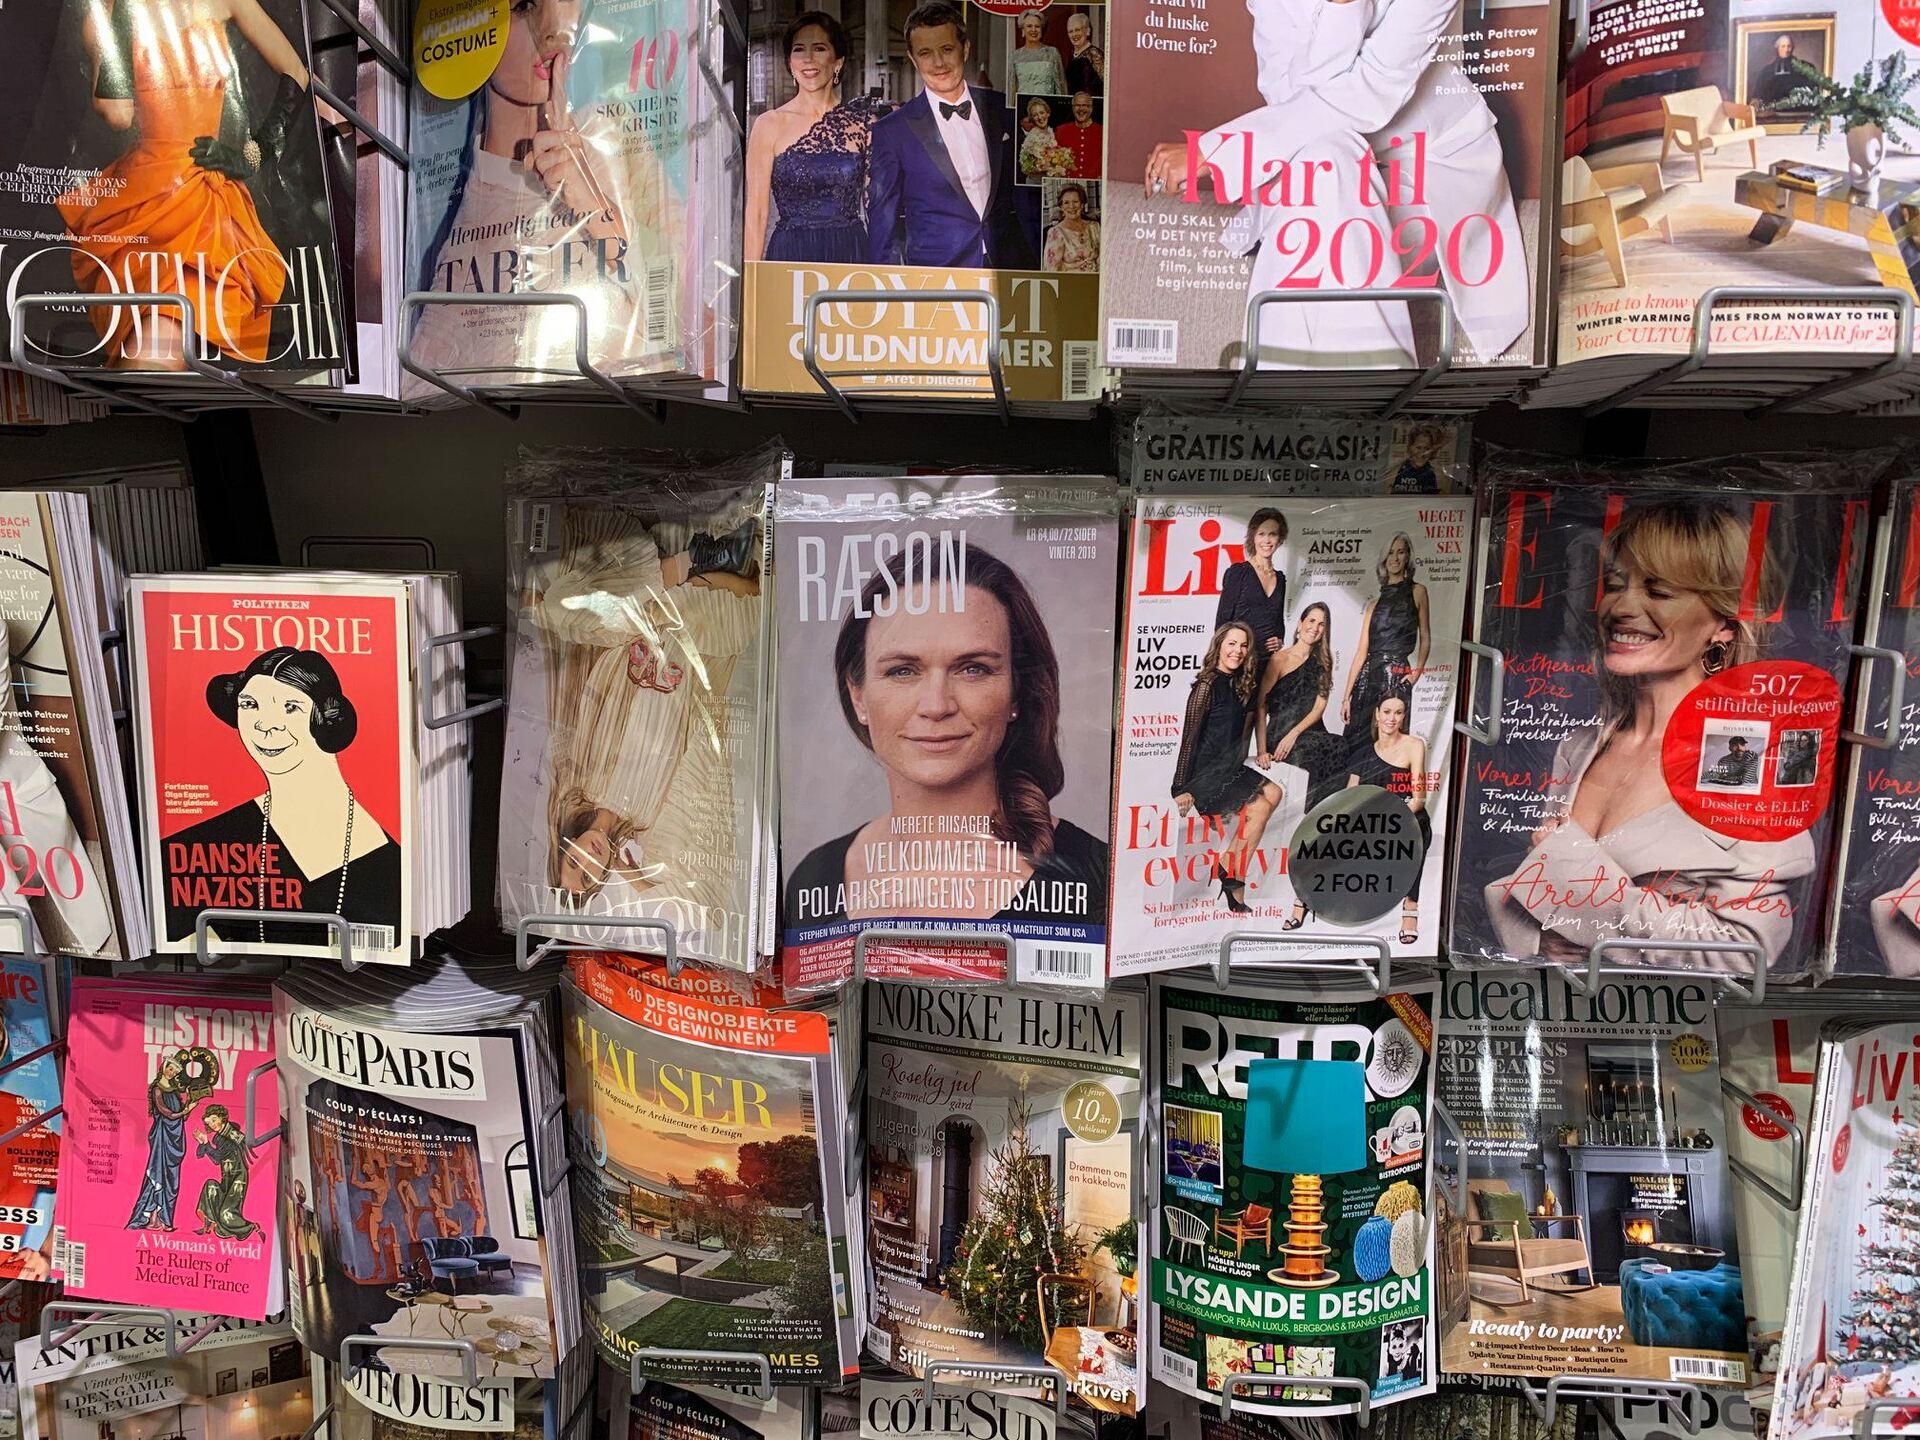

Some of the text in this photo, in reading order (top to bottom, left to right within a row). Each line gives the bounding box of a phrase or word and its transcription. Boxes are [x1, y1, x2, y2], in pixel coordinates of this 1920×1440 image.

[1145, 12, 1210, 32] du huske
[1591, 0, 1699, 34] FROM LONDON'S
[421, 28, 497, 64] COSTUME
[1136, 32, 1217, 55] 10'erne for?
[1600, 30, 1685, 58] LAST-MINUTE
[1606, 41, 1678, 65] GIFT IDEAS
[626, 30, 680, 94] 10
[1427, 45, 1535, 63] Caroline Søeborg
[1451, 62, 1510, 76] Ahlefeldt
[17, 163, 102, 178] Regreso al pasado
[1180, 129, 1428, 207] Klar til
[22, 193, 97, 206] DE LO RETRO
[1131, 212, 1250, 228] ALT DU SKAL VIDE
[1135, 228, 1217, 242] OM DET NYE
[1275, 213, 1505, 289] 2020
[1159, 260, 1249, 275] film, kunst &
[1156, 275, 1248, 290] begivenheder
[785, 269, 1059, 333] ROYALT
[1577, 313, 1690, 331] WINTER-WARMING
[1788, 312, 1841, 320] NORWAY
[1848, 312, 1862, 320] TO
[1867, 312, 1888, 320] THE
[1576, 324, 1873, 350] Your CALENDAR for
[1146, 434, 1380, 461] GRATIS MAGASIN
[1144, 469, 1377, 482] EN GAVE TIL DEJLIGE DIG FRA OS!
[1144, 505, 1223, 518] MAGASINET
[1418, 510, 1465, 524] MEGET
[1026, 528, 1036, 541] KR
[1074, 528, 1097, 541] SIDER
[1425, 526, 1464, 539] MERE
[1049, 546, 1096, 560] VINTER 2019
[1309, 540, 1362, 554] ANGST
[1436, 540, 1462, 554] SEX
[798, 530, 966, 622] RÆSON
[232, 599, 310, 610] POLITIKEN
[170, 613, 372, 654] HISTORIE
[1137, 625, 1205, 634] SE VINDERNE!
[1137, 638, 1165, 653] LIV
[1135, 656, 1201, 671] MODEL
[1134, 674, 1171, 689] 2019
[1750, 674, 1803, 696] 507
[1695, 696, 1838, 717] stilfulde julegaver
[1131, 715, 1178, 725] NYTÅRS
[1131, 727, 1179, 738] MENUEN
[1145, 742, 1177, 750] champagne
[164, 783, 209, 791] Forfatteren
[165, 791, 210, 800] Olga Eggers
[1482, 788, 1572, 804] Familierne
[184, 799, 218, 807] glødende
[1701, 798, 1813, 813] Dossier & ELLE-
[891, 815, 995, 834] MERETE RIISAGER:
[1316, 814, 1401, 835] GRATIS
[1710, 812, 1803, 828] postkort til dig
[169, 843, 280, 874] DANSKE
[864, 840, 1021, 874] VELKOMMEN TIL
[1296, 839, 1414, 861] MAGASIN
[171, 876, 303, 909] NAZISTER
[1313, 874, 1393, 893] 2 FOR 1
[1493, 852, 1801, 918] Årets Kvinder
[798, 877, 1088, 919] POLARISERINGENS TIDSALDER
[799, 925, 1087, 941] STEPHEN WALT: MAGTFULDT SOM USA
[627, 987, 798, 1033] 40 DESIGNOBJEKTE
[143, 1004, 273, 1053] HISTORY
[643, 1008, 776, 1047] ZU GEWINNEN!
[876, 982, 1125, 1058] NORSKE HJEM
[326, 1098, 416, 1125] COUP D'ÉCLATS
[594, 1080, 742, 1139] The Magazine for Architecture & Design
[1069, 1161, 1127, 1179] Drømmen om
[1379, 1162, 1422, 1180] BISTROPORSLIN
[1081, 1174, 1126, 1190] kakkelovn
[137, 1233, 261, 1260] A Woman's World
[136, 1249, 231, 1273] The Rulers of
[1208, 1256, 1261, 1271] MÖBLER UNDER
[1208, 1263, 1252, 1277] FALSK FLAGG
[135, 1267, 250, 1294] Medieval France
[1164, 1267, 1421, 1320] LYSANDE DESIGN
[1468, 1319, 1625, 1344] Ready to party!
[82, 1368, 156, 1391] Vinterhygge
[1567, 1366, 1615, 1374] Readymades
